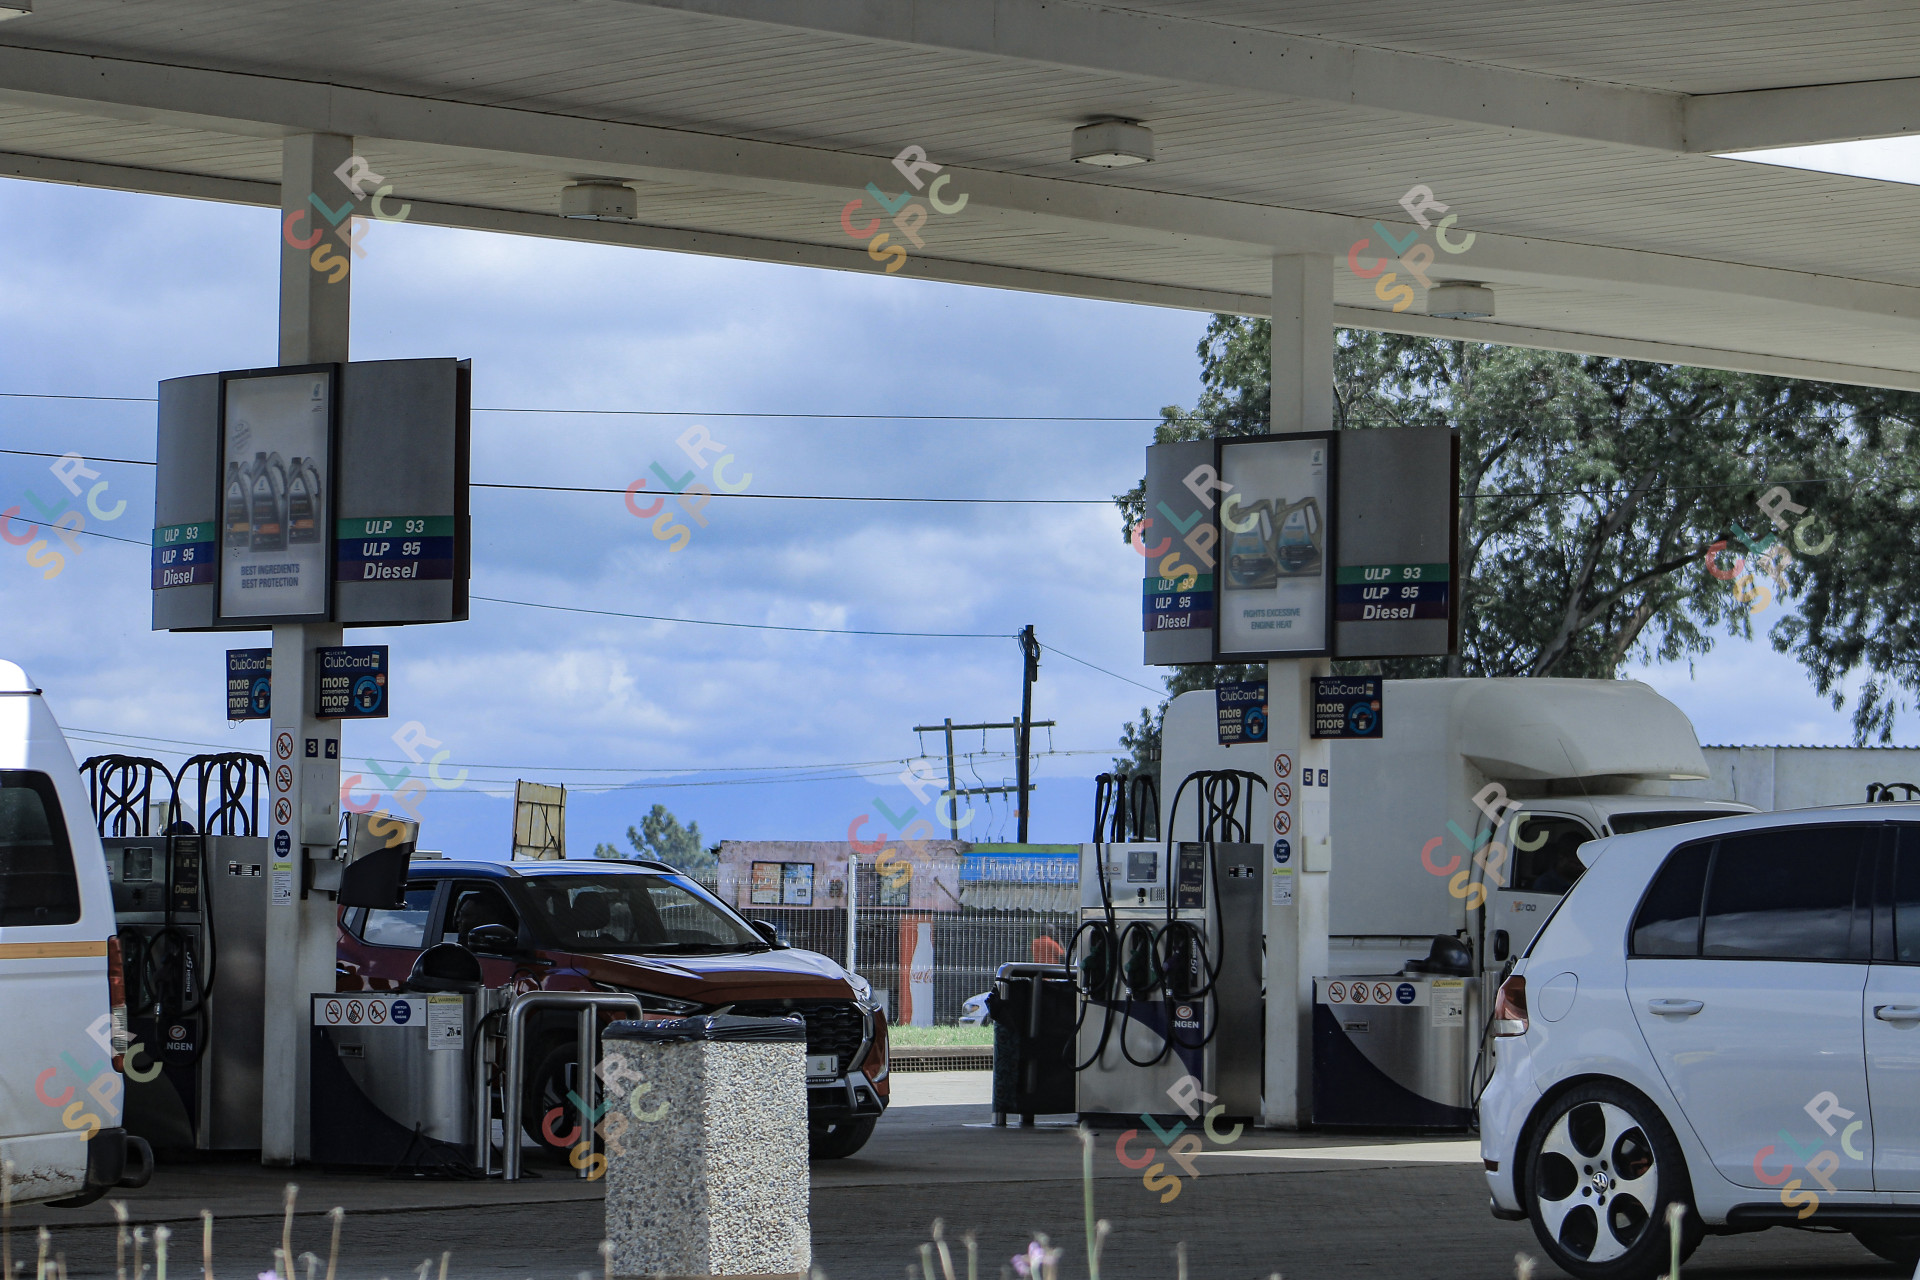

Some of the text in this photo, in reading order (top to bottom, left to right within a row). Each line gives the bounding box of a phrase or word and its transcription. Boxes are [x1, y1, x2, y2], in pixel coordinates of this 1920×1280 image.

[365, 520, 425, 535] ULP 93
[164, 527, 198, 543] ULP 93
[362, 542, 421, 556] ULP 95
[162, 548, 194, 564] ULP 95
[241, 563, 300, 576] BEST INGREDIENTS
[364, 561, 418, 579] Diesel
[1364, 567, 1421, 581] ULP 93
[163, 567, 194, 586] Diesel
[242, 576, 299, 588] BEST PROTECTION
[1157, 577, 1195, 591] ULP 93
[1362, 586, 1419, 600] ULP 95
[1155, 596, 1191, 609] ULP 95
[1243, 608, 1301, 618] FIGHTS EXCESSIVE
[1362, 604, 1415, 619] Diesel
[1157, 613, 1191, 629] Diesel
[1251, 620, 1292, 630] ENGINE HEAT
[230, 658, 265, 671] ClubCard
[324, 655, 370, 668] ClubCard
[229, 679, 250, 690] more
[322, 676, 350, 688] more
[1220, 689, 1257, 702] ClubCard
[1318, 684, 1364, 695] ClubCard
[229, 697, 249, 708] more
[322, 695, 350, 707] more
[1219, 708, 1242, 719] more
[1316, 703, 1345, 713] more
[1219, 724, 1242, 735] more
[1316, 719, 1345, 729] more
[308, 741, 337, 755] 3 4
[1305, 771, 1327, 784] 5 6
[175, 884, 198, 895] Diesel
[1180, 883, 1203, 893] Diesel
[1190, 958, 1198, 974] 50
[1172, 1020, 1199, 1029] NGEN
[166, 1042, 193, 1051] NGEN
